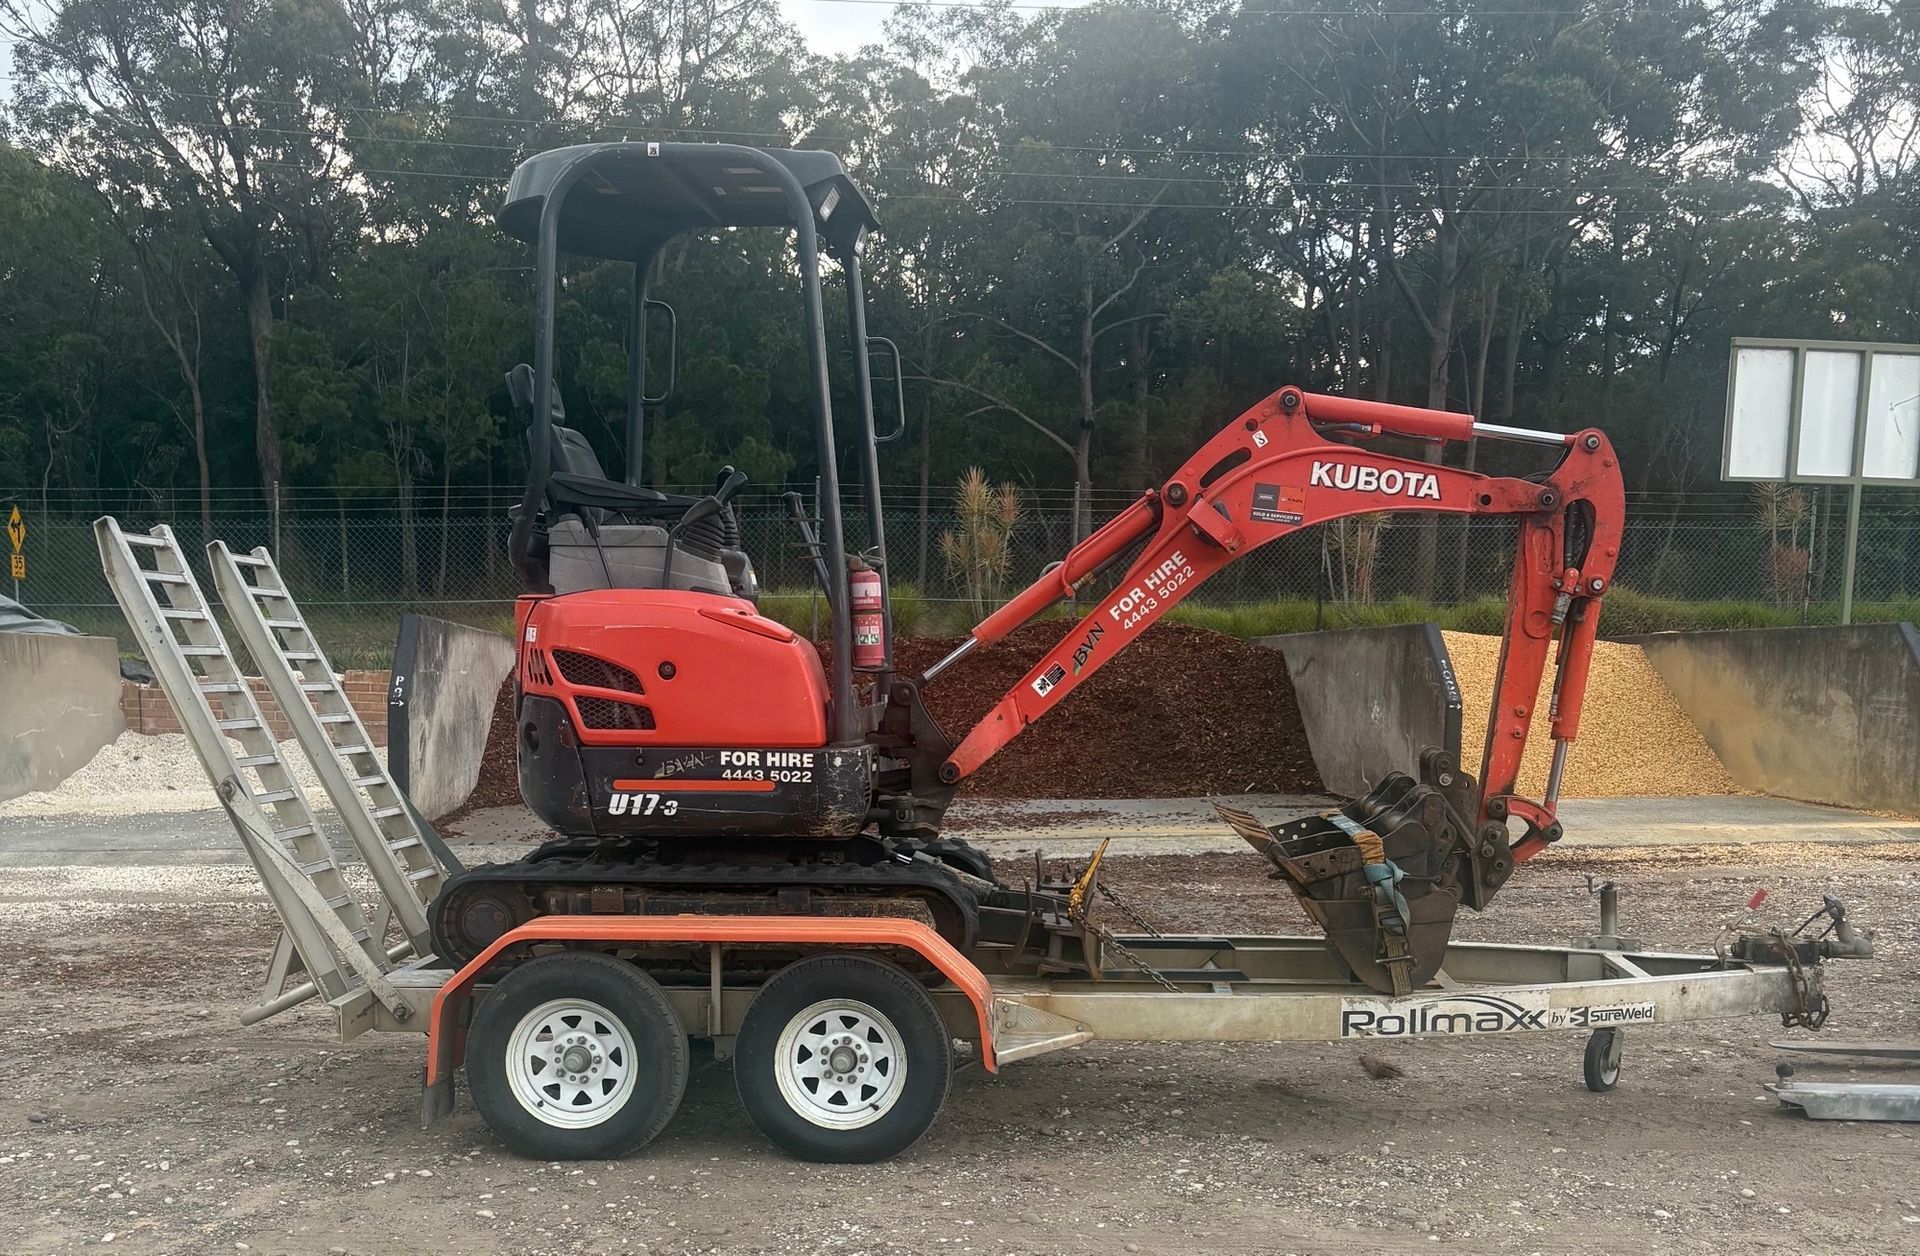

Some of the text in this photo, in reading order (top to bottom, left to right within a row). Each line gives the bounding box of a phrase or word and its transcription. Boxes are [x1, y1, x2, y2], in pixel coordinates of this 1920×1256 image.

[1309, 460, 1442, 501] KUBOTA
[1109, 550, 1187, 621] FOR HIRE
[1124, 565, 1195, 630] 4443 5022
[720, 751, 814, 768] FOR HIRE
[722, 769, 812, 783] 4443 5022
[608, 793, 679, 816] U17-3
[1342, 1005, 1653, 1037] Rollmaxx by SureWeld
